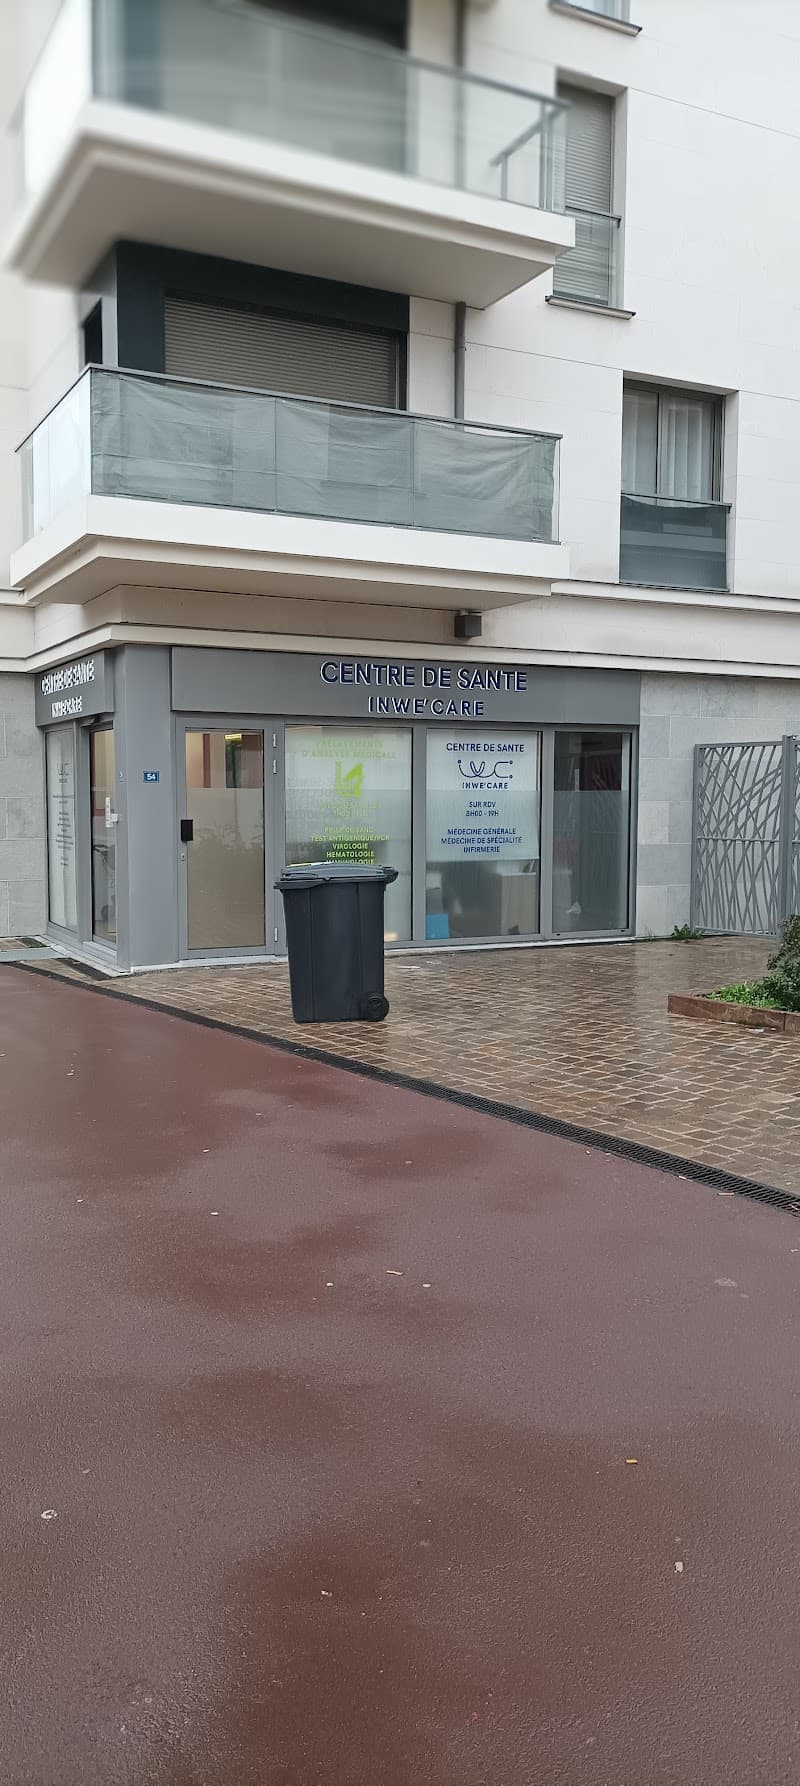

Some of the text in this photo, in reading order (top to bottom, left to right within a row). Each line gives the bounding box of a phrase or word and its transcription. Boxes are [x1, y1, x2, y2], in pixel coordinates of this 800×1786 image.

[320, 660, 528, 692] CENTRE DE SANTE
[367, 695, 485, 717] INWE'CARE
[446, 742, 525, 753] CENTRE DE SANTE
[146, 773, 156, 781] 54
[332, 842, 369, 850] VIROLOGIE
